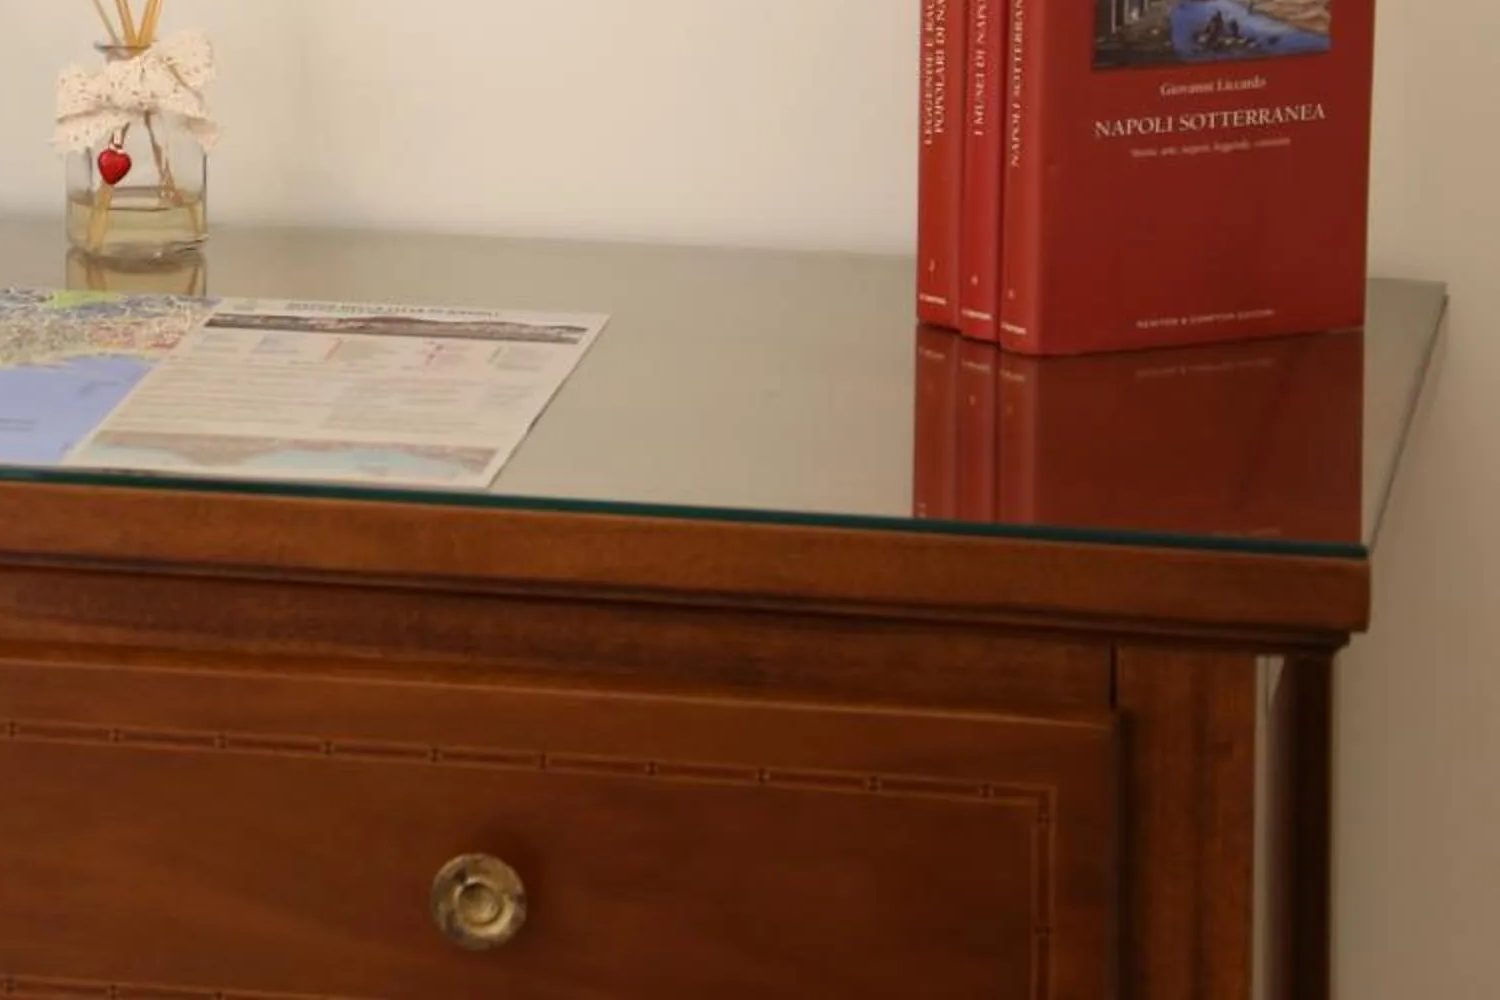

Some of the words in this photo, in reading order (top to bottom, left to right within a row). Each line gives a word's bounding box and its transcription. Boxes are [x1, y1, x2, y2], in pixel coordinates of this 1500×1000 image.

[936, 26, 947, 44] DI
[934, 49, 947, 134] POPOLARI
[974, 73, 986, 125] MUSEI
[1010, 103, 1023, 168] NAPOLI
[1095, 115, 1174, 137] NAPOLI
[1178, 103, 1326, 132] SOTTERRANEA
